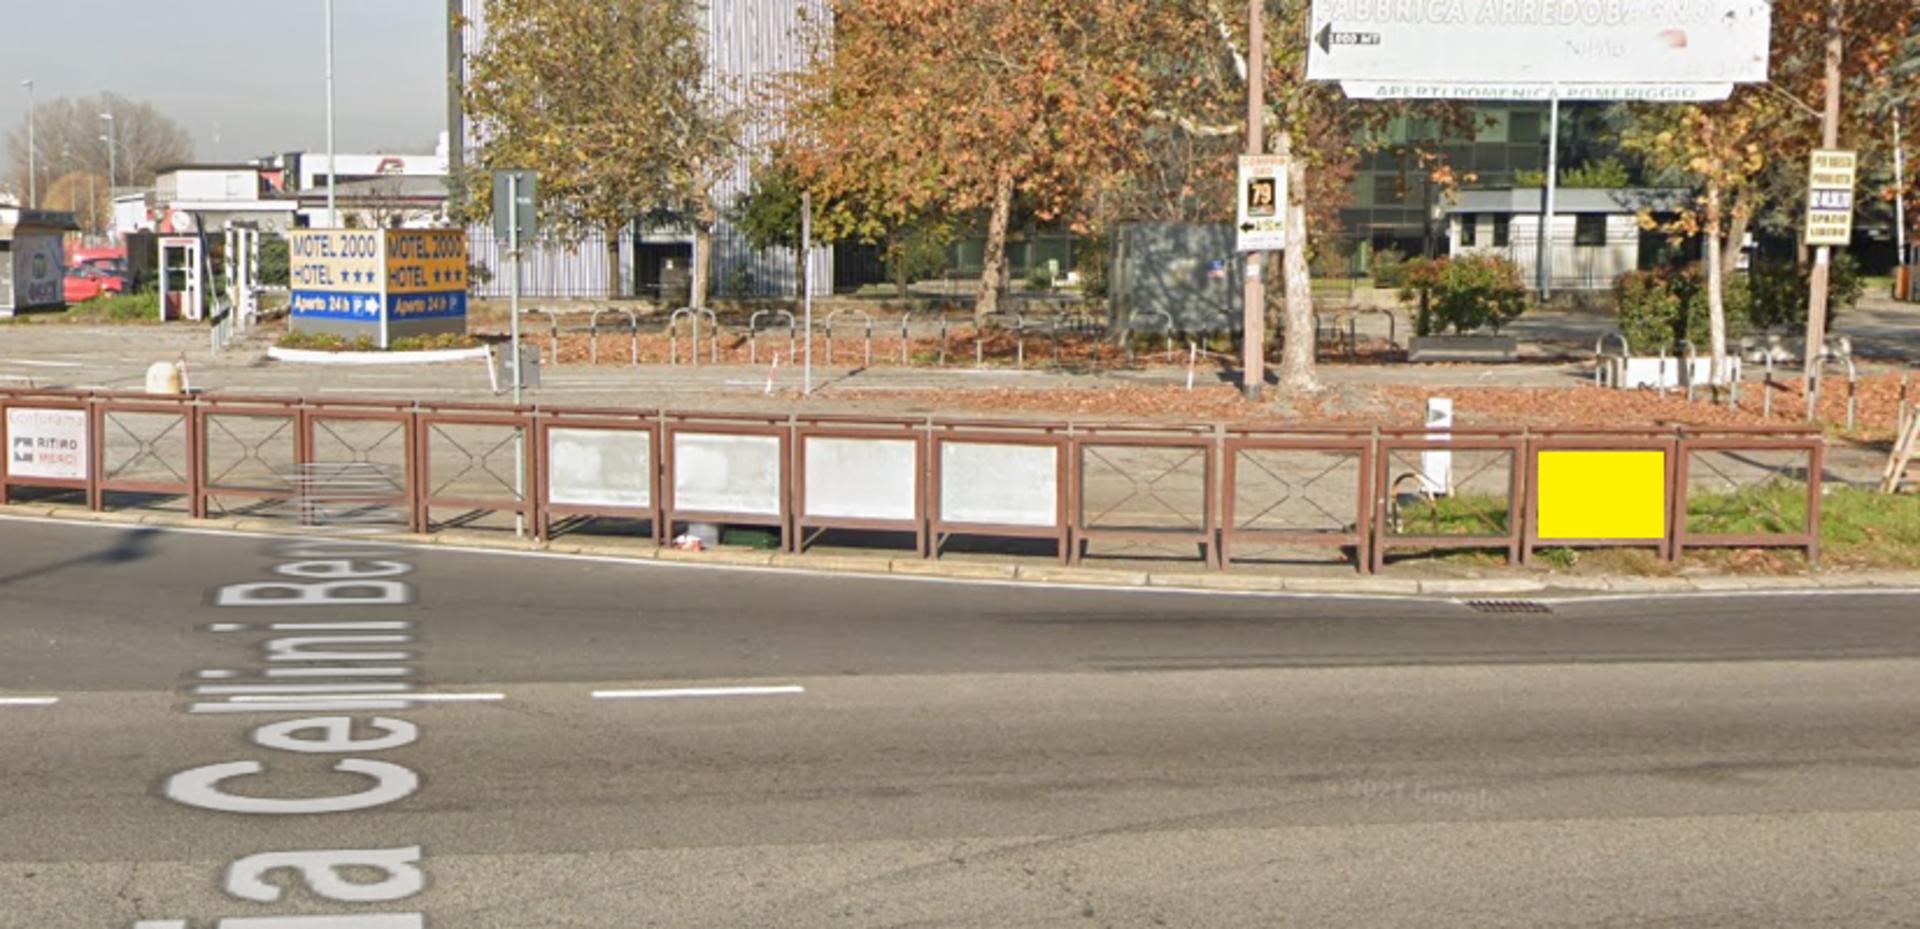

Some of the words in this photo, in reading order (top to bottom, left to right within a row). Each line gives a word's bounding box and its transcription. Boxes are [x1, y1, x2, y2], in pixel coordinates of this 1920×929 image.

[1316, 0, 1465, 23] FABBRICA
[1252, 183, 1272, 206] 79
[293, 234, 337, 258] MOTEL
[340, 234, 376, 258] 2000
[388, 234, 431, 260] MOTEL
[432, 234, 462, 259] 2000
[294, 263, 334, 286] HOTEL
[390, 264, 428, 287] HOTEL
[38, 437, 78, 450] RITIRO
